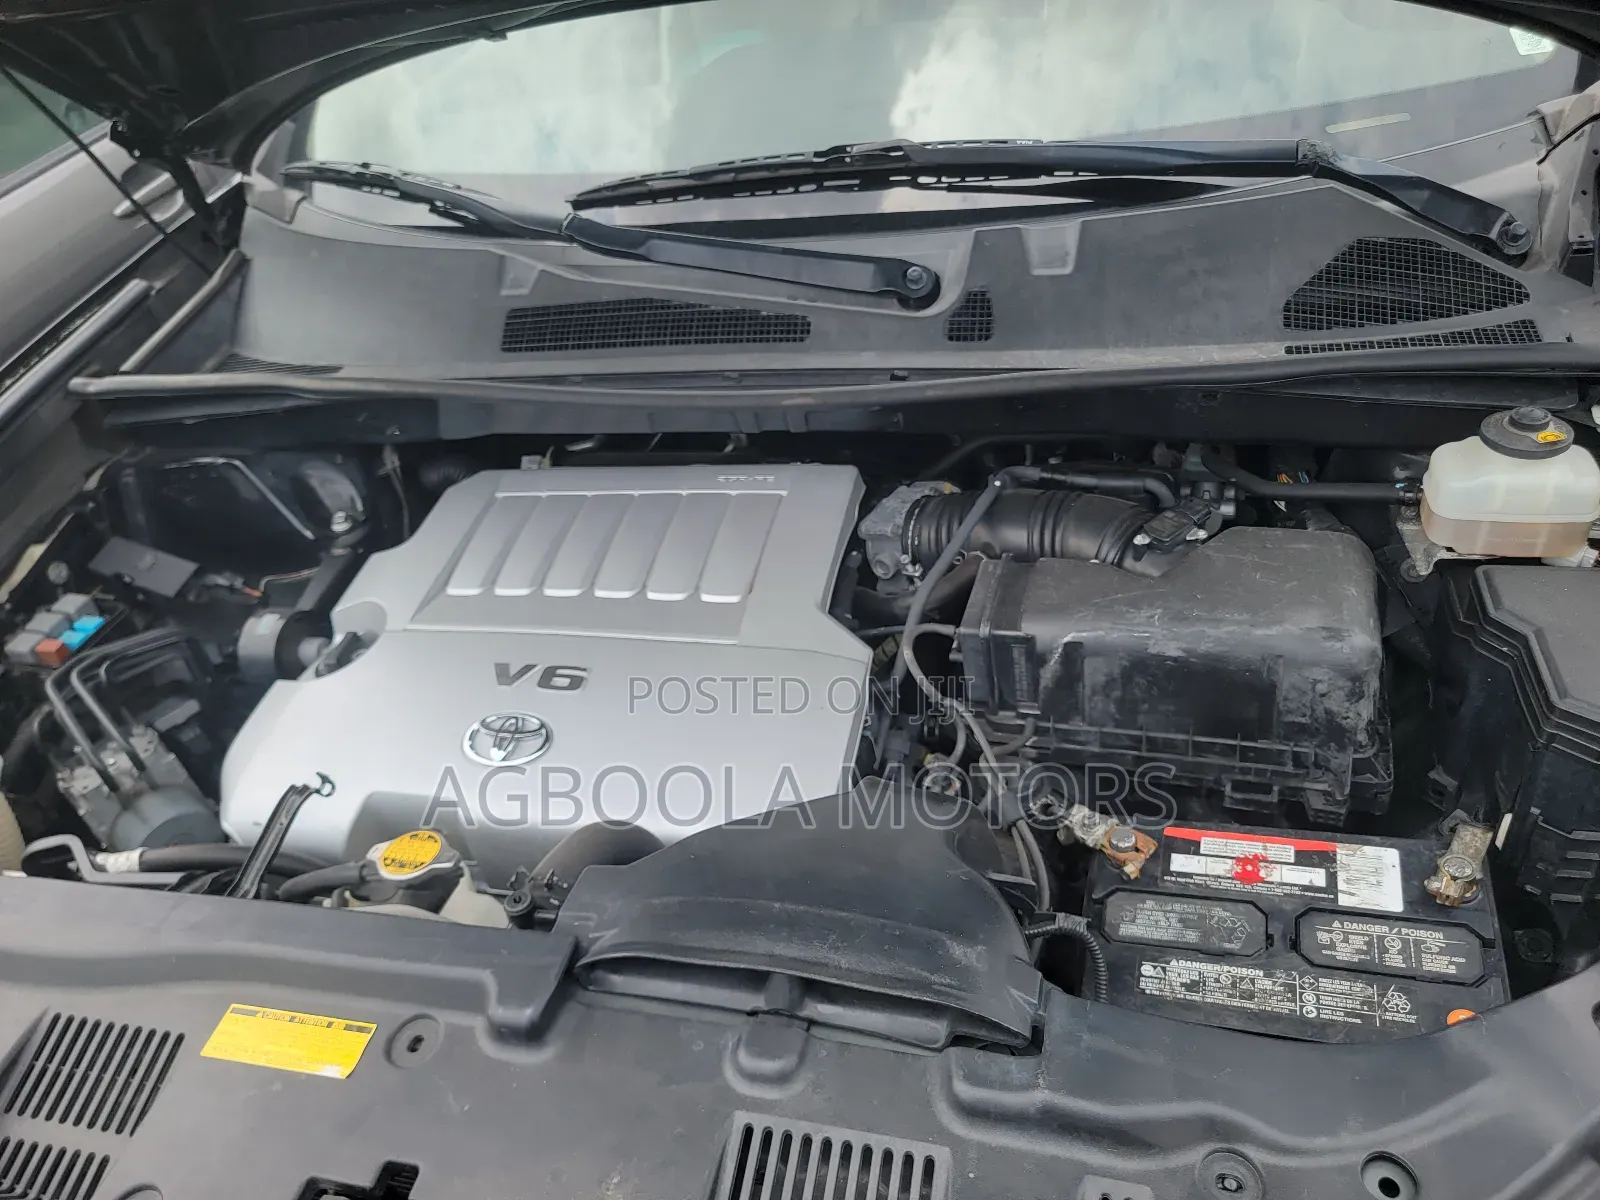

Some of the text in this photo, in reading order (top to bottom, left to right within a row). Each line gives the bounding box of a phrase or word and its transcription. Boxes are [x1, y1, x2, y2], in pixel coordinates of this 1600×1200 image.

[494, 662, 588, 691] V6
[1343, 921, 1390, 934] DANGER
[1401, 928, 1444, 940] POISON
[1179, 959, 1264, 977] DANGER/POISON
